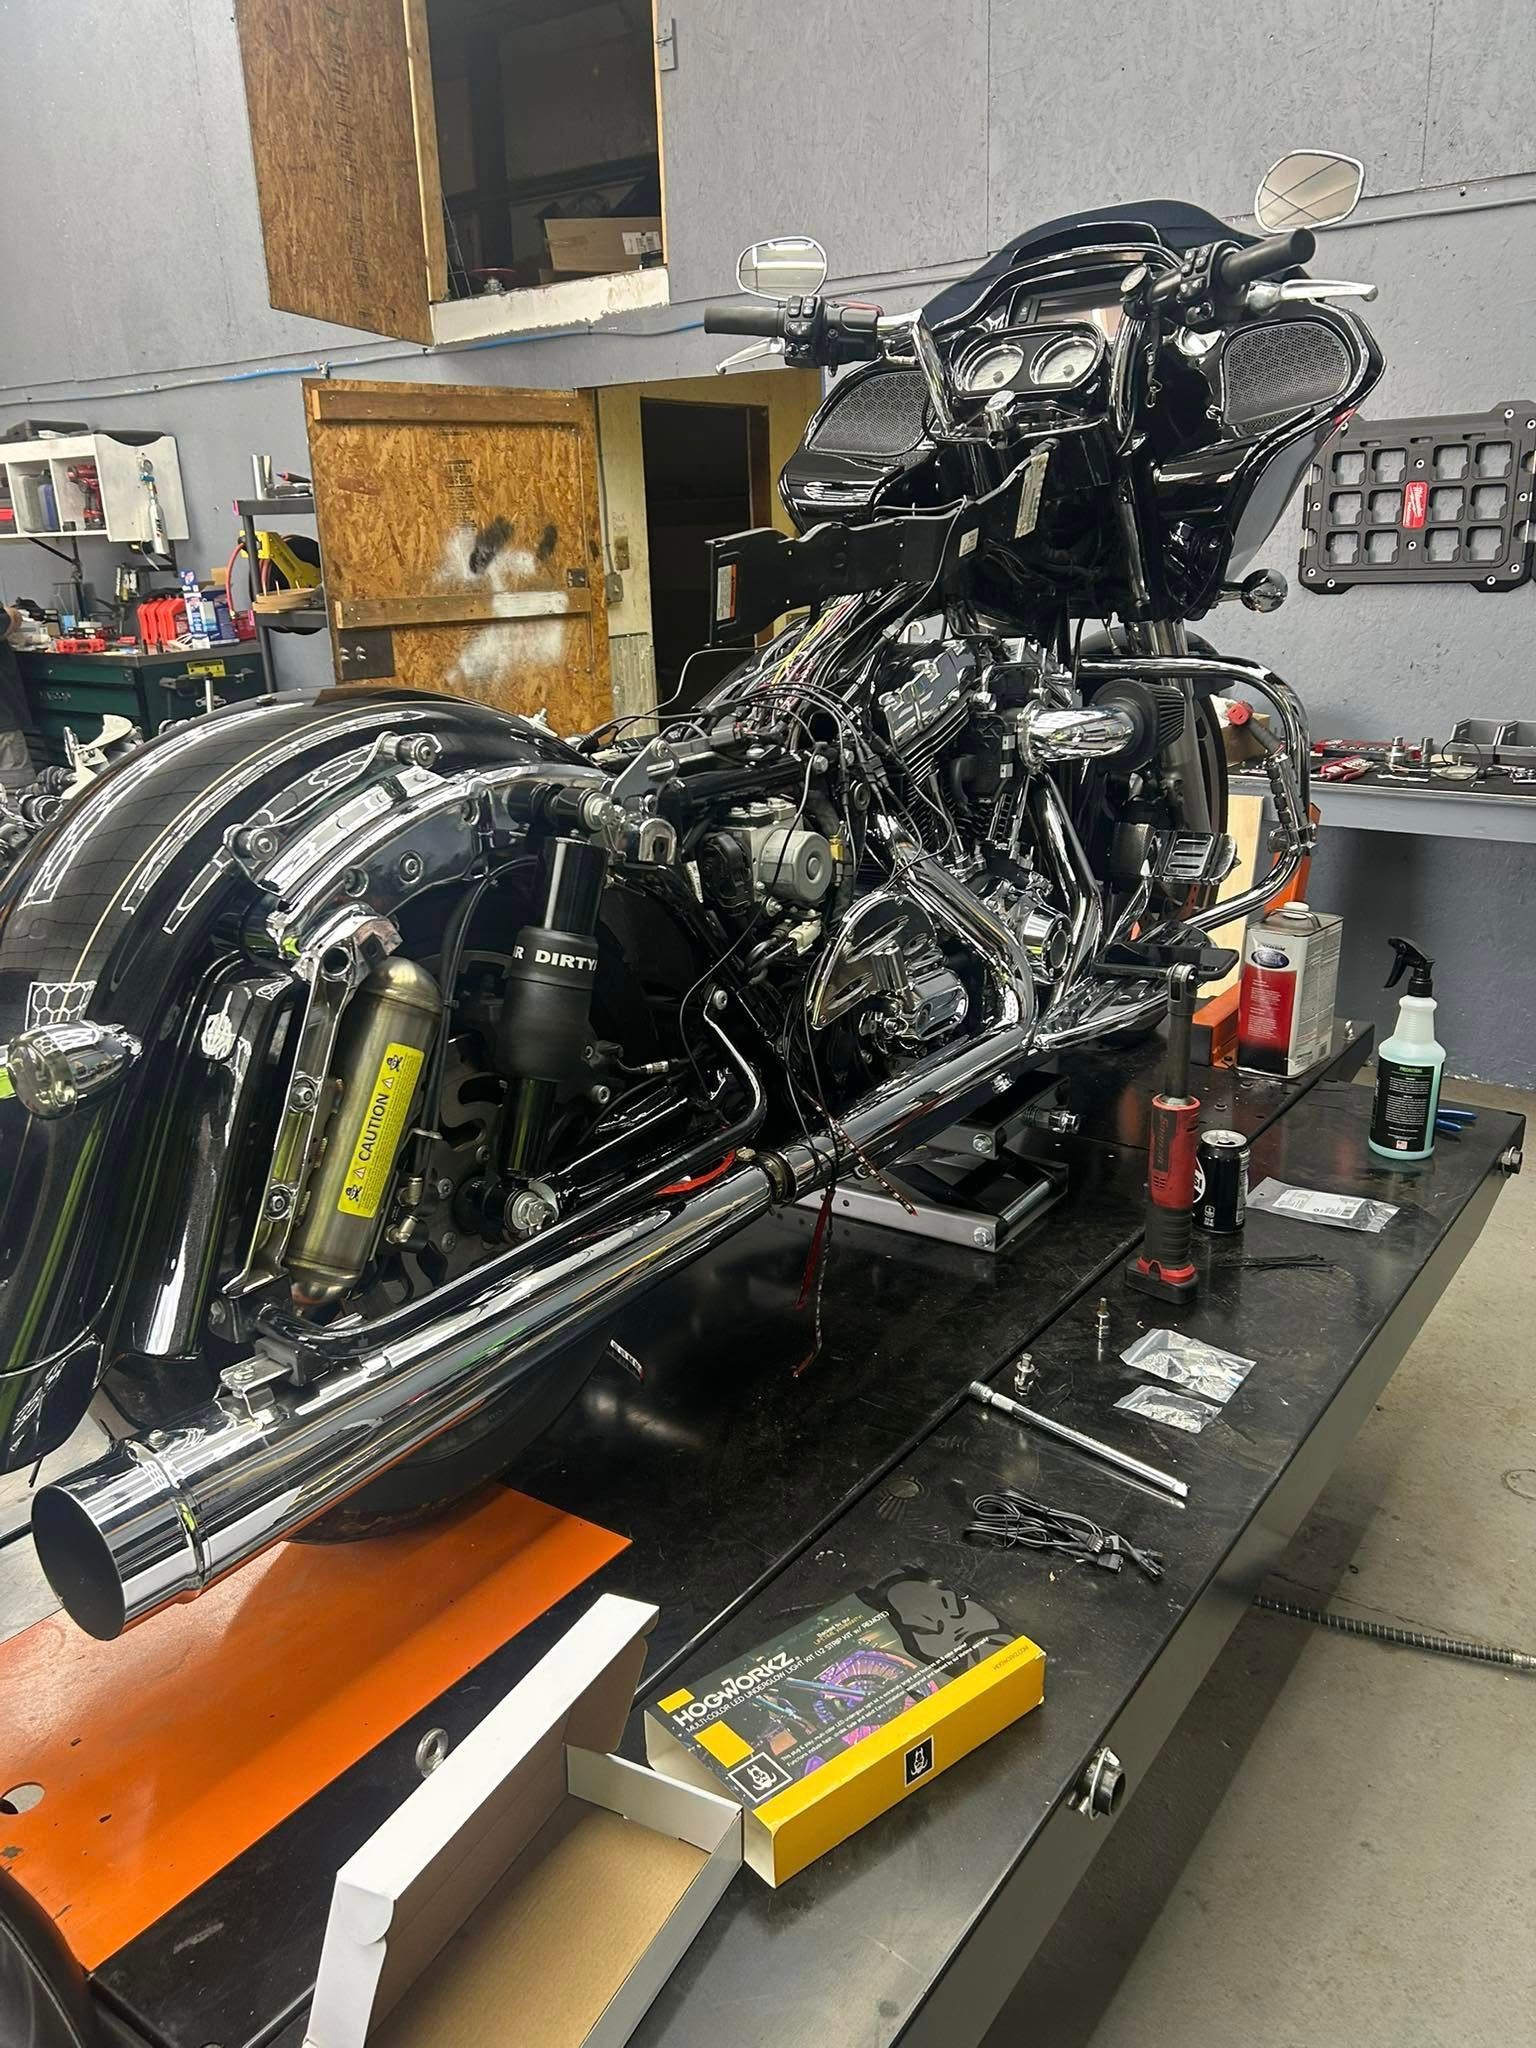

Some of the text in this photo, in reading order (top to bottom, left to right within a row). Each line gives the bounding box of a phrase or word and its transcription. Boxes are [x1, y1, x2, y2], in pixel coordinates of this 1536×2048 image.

[534, 949, 596, 971] DIRTY
[359, 1093, 389, 1161] CAUTION
[687, 1703, 729, 1732] MULTI-COLOR
[731, 1695, 744, 1706] LED
[745, 1671, 785, 1698] UNDERGLOW
[786, 1660, 804, 1673] LIGHT
[804, 1654, 814, 1662] KIT
[814, 1647, 825, 1656] (12
[825, 1637, 843, 1650] STRIP
[842, 1631, 853, 1640] KIT
[861, 1610, 889, 1628] REMOTE)
